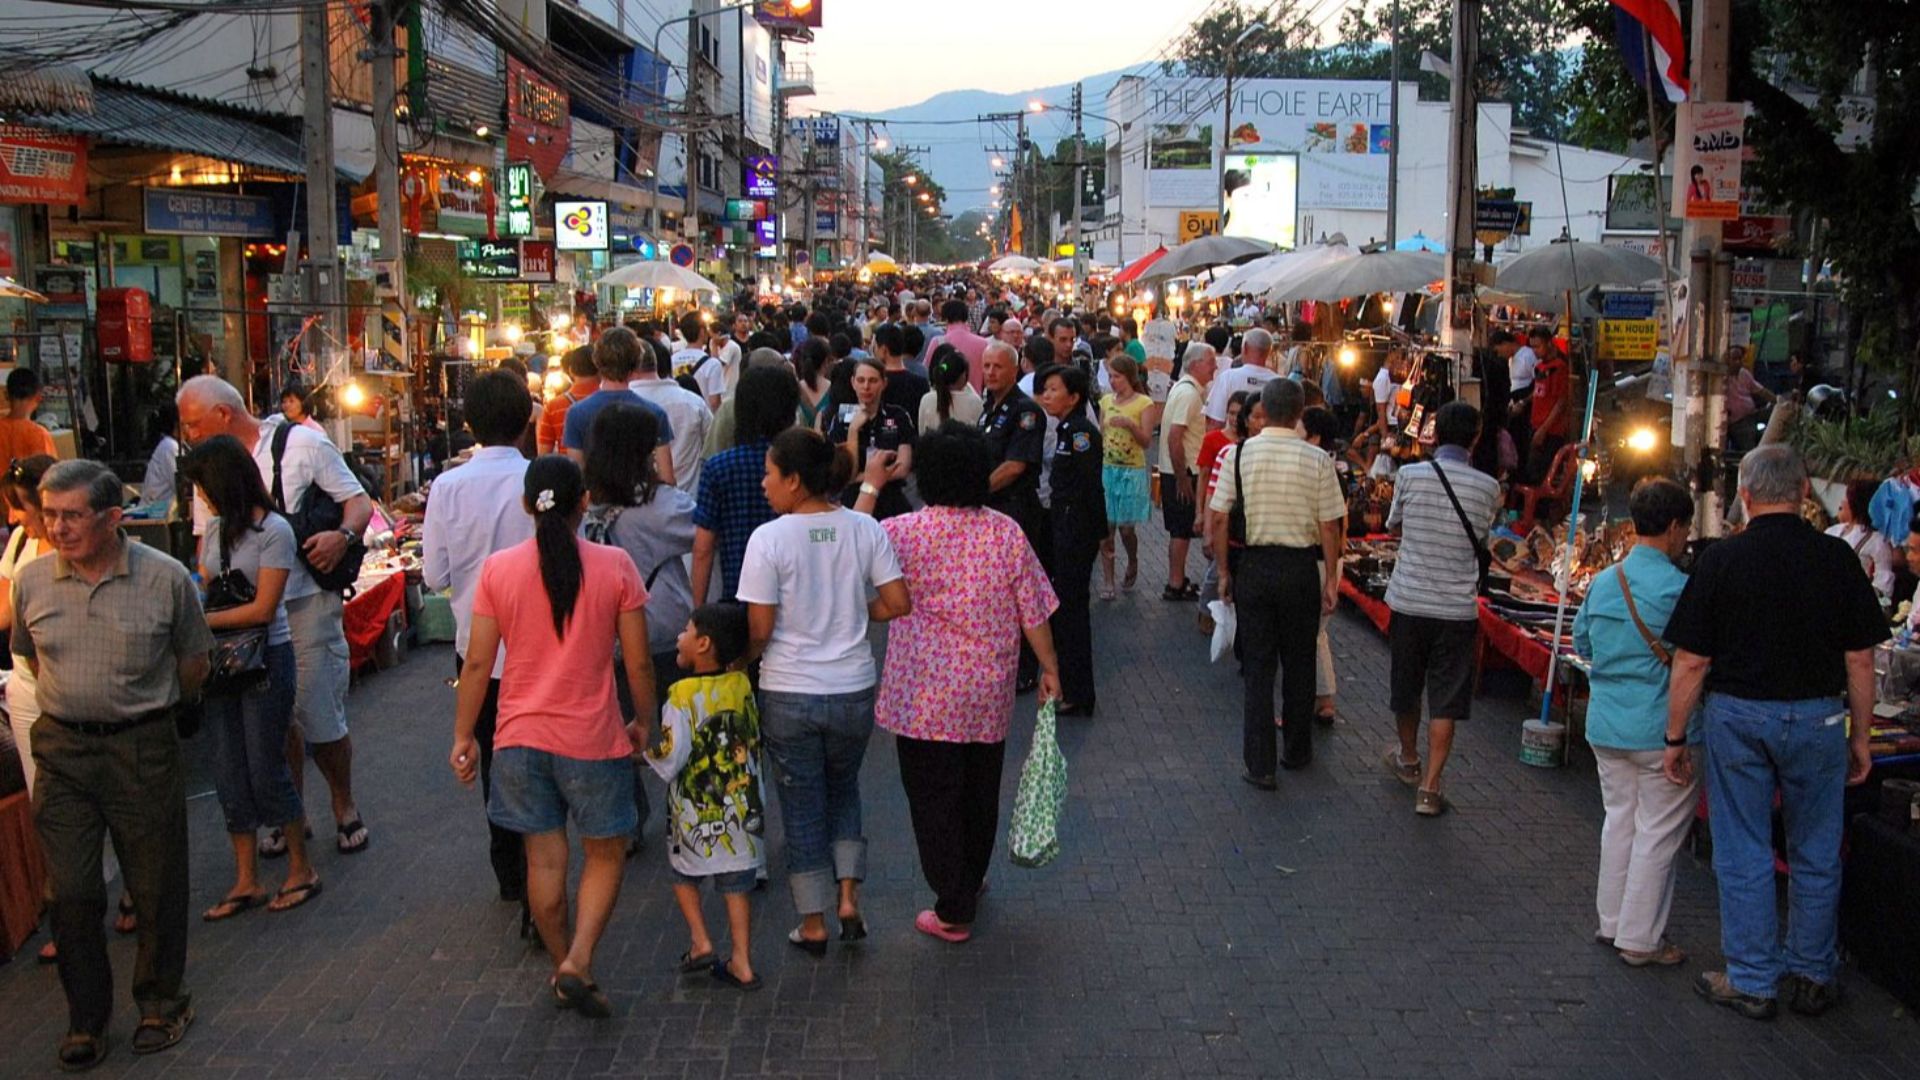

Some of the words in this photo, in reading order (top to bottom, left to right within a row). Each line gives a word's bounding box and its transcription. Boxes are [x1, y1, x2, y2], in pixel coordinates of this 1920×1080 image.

[1151, 89, 1195, 114] THE
[1207, 89, 1306, 116] WHOLE
[1318, 91, 1391, 117] EARTH
[168, 195, 203, 213] CENTER
[206, 199, 232, 215] PLACE
[236, 201, 257, 216] TOUR
